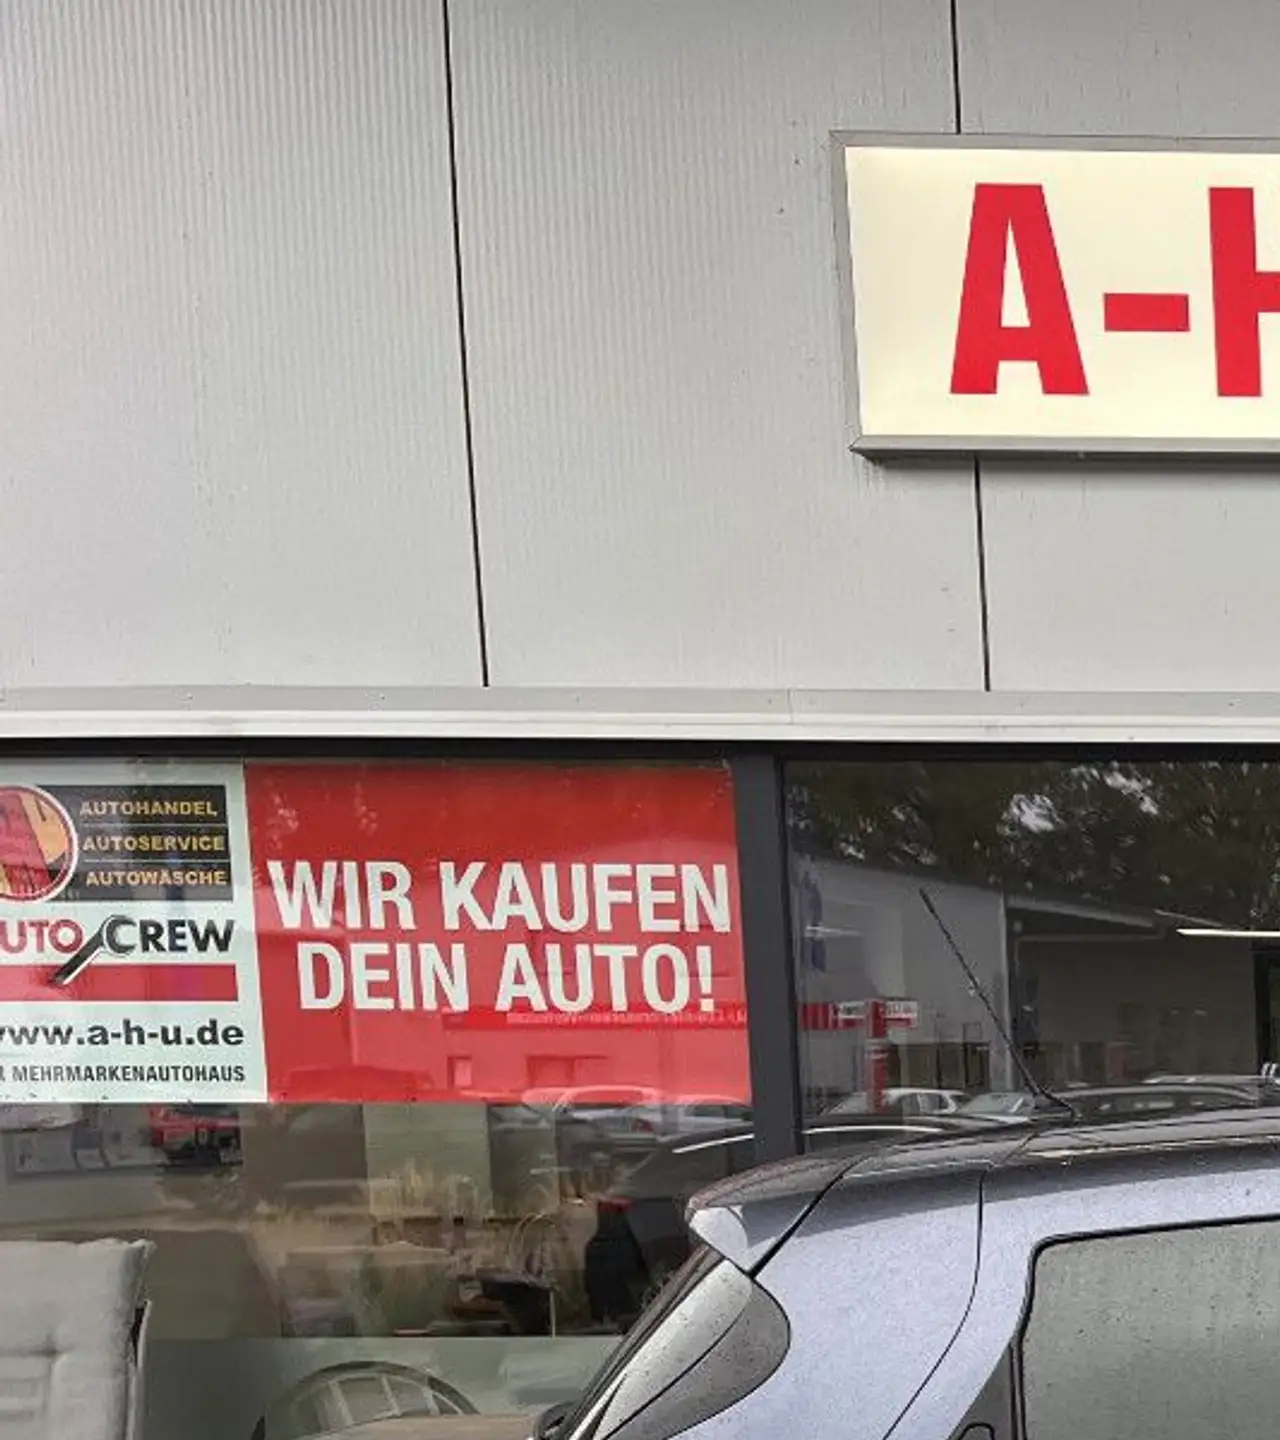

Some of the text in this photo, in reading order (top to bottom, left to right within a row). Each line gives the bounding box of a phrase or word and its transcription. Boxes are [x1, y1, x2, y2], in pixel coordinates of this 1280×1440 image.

[79, 801, 218, 817] AUTOHANDEL
[82, 835, 225, 852] AUTOSERVICE
[85, 868, 229, 887] AUTOWÄSCHE
[267, 860, 732, 934] WIR KAUFEN
[0, 918, 236, 954] UTO CREW
[299, 942, 715, 1013] DEIN AUTO!
[0, 1018, 245, 1046] ww.a-h-u.de
[12, 1064, 245, 1083] MEHRMARKENAUTOHAUS
